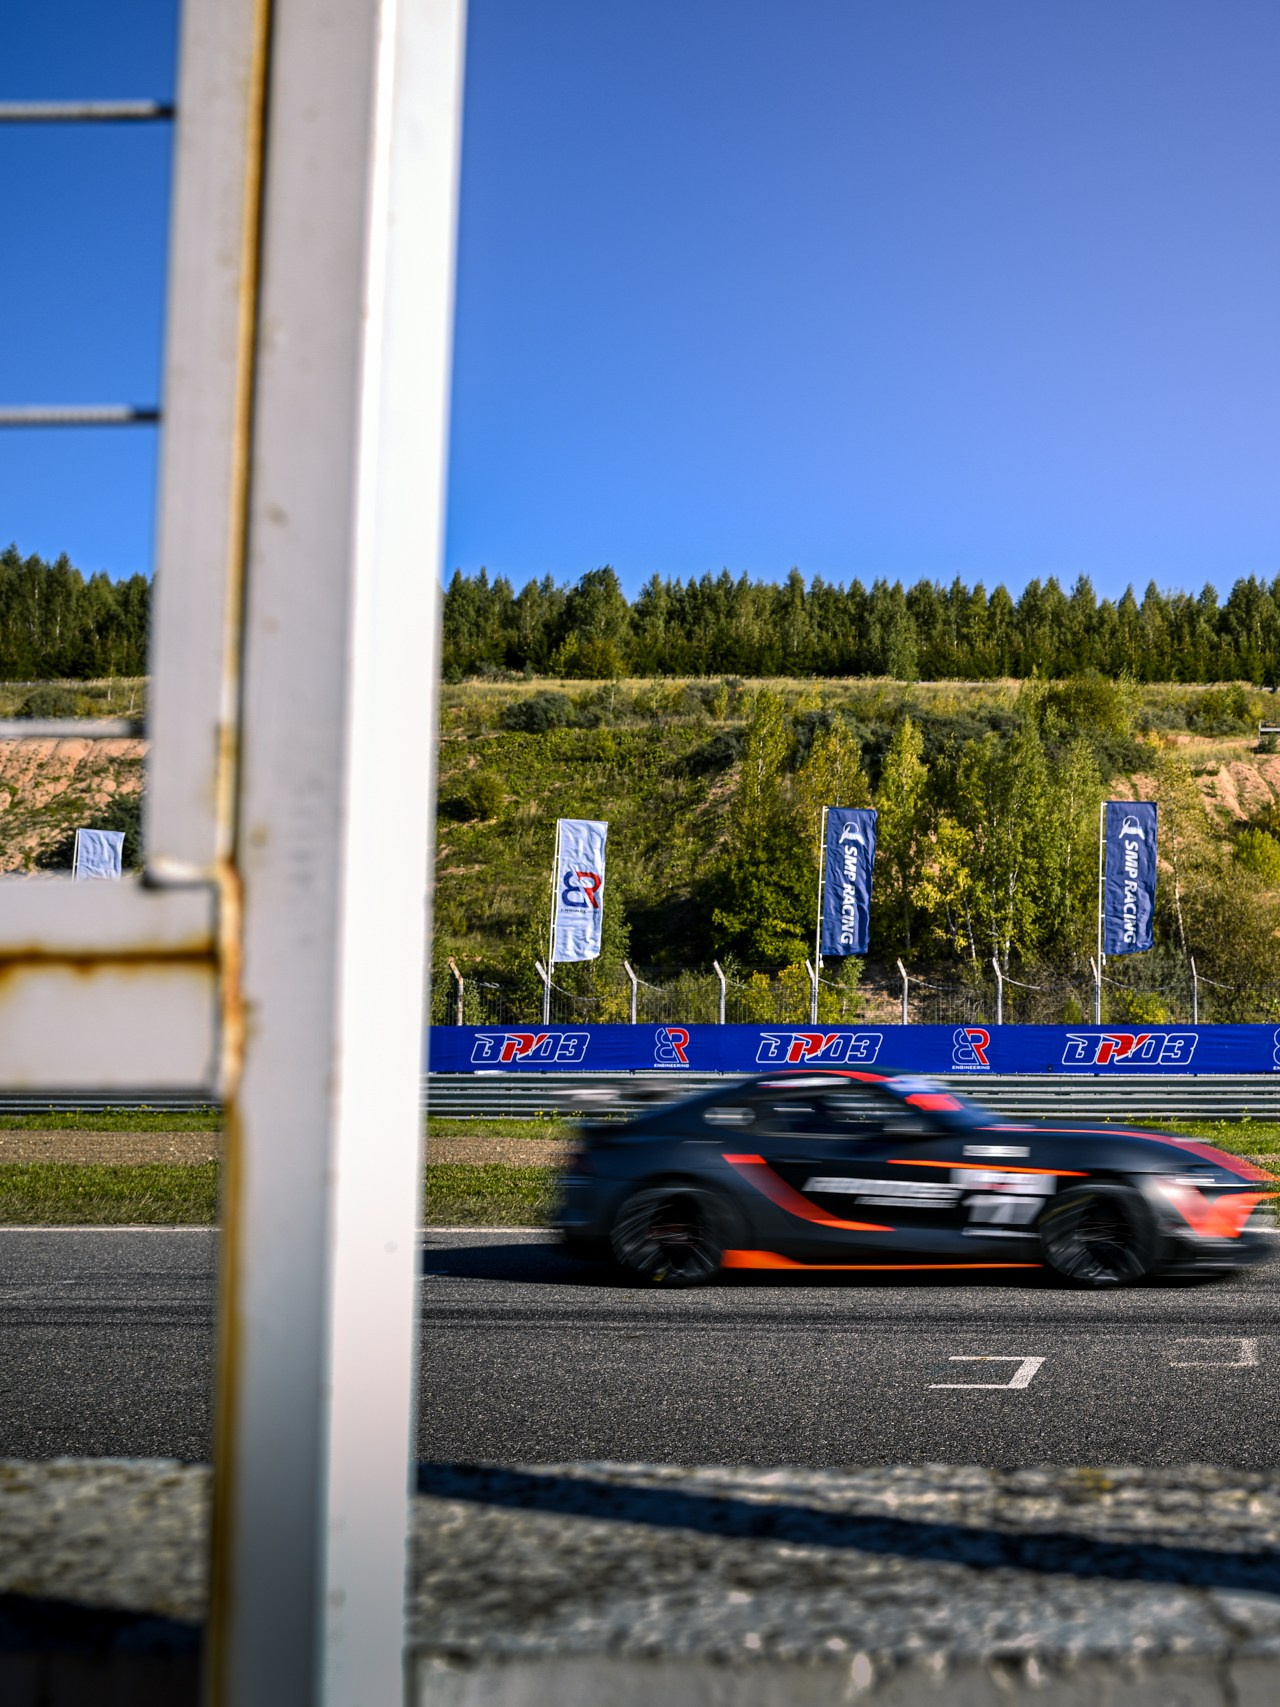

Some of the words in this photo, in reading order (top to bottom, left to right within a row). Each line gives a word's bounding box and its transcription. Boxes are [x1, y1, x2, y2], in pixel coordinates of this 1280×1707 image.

[843, 845, 857, 882] SMP
[1124, 840, 1138, 879] SMP
[840, 882, 856, 945] RACING
[1123, 880, 1138, 944] RACING
